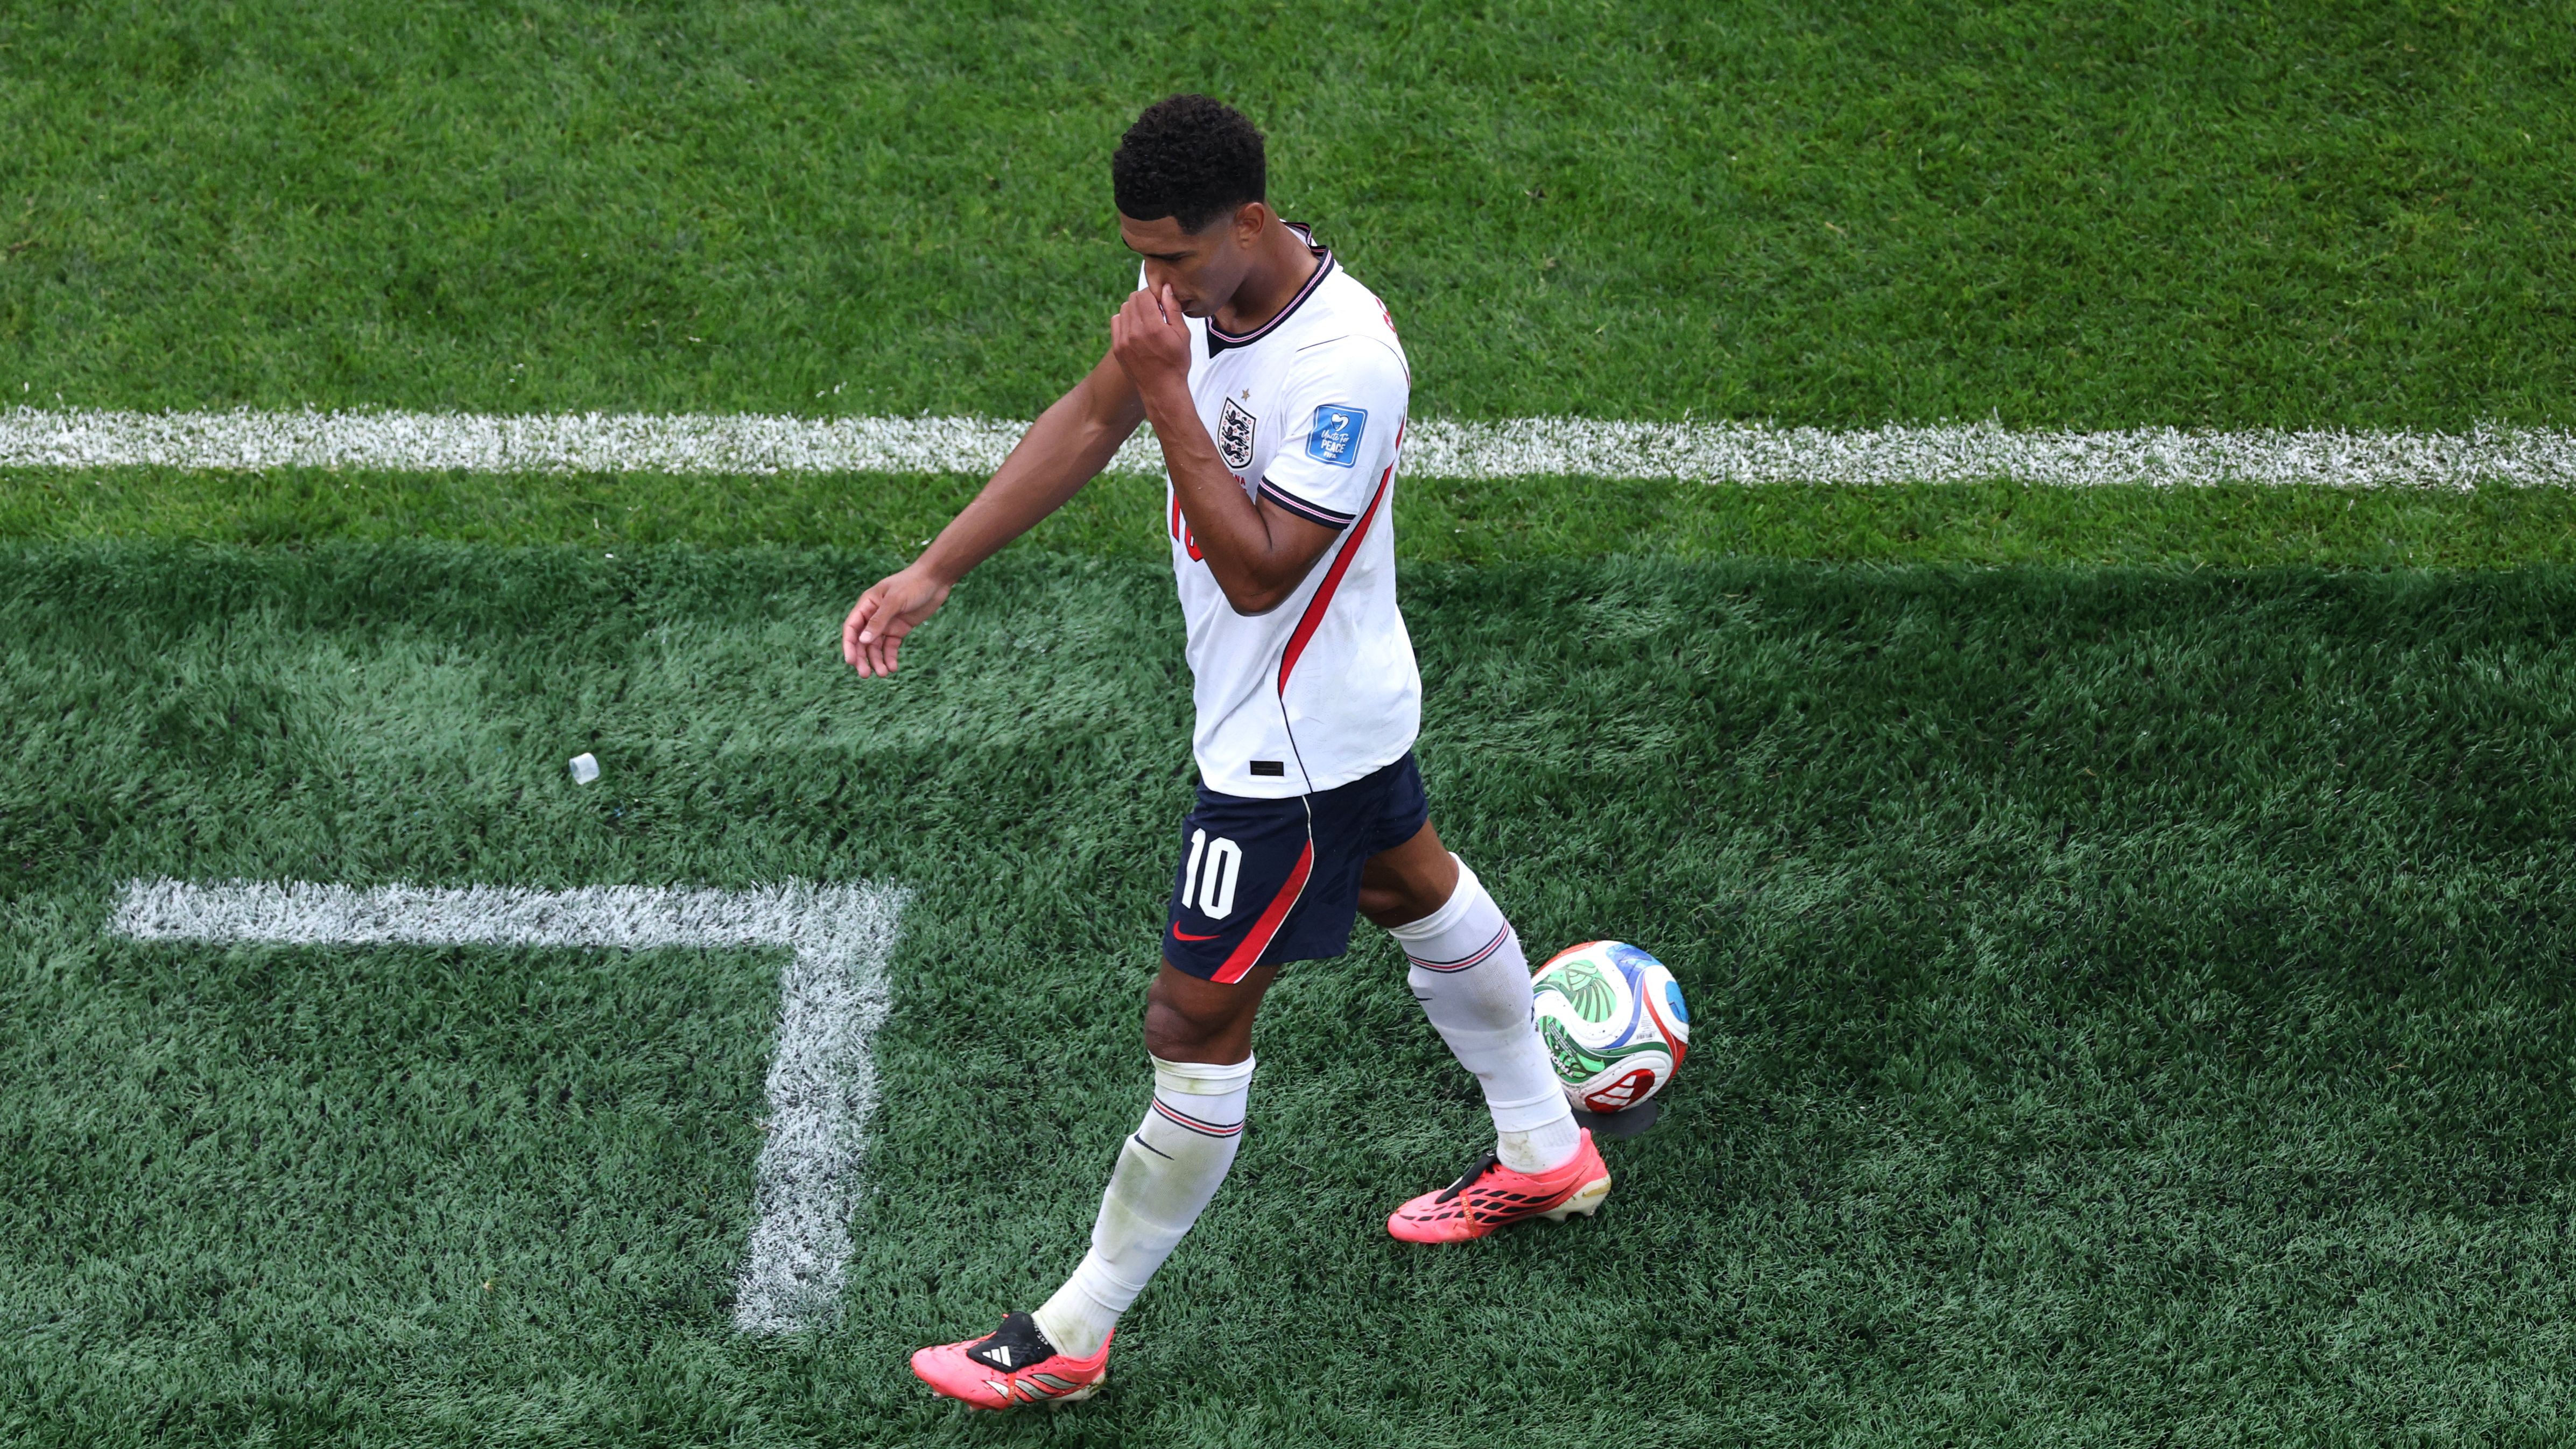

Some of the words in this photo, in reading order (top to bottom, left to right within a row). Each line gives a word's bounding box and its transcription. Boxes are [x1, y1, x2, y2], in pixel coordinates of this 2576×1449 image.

[1321, 430, 1340, 441] Unite
[1339, 433, 1349, 443] For
[1321, 439, 1346, 453] PEACE
[1181, 827, 1243, 920] 10
[1549, 1049, 1574, 1078] TRION
